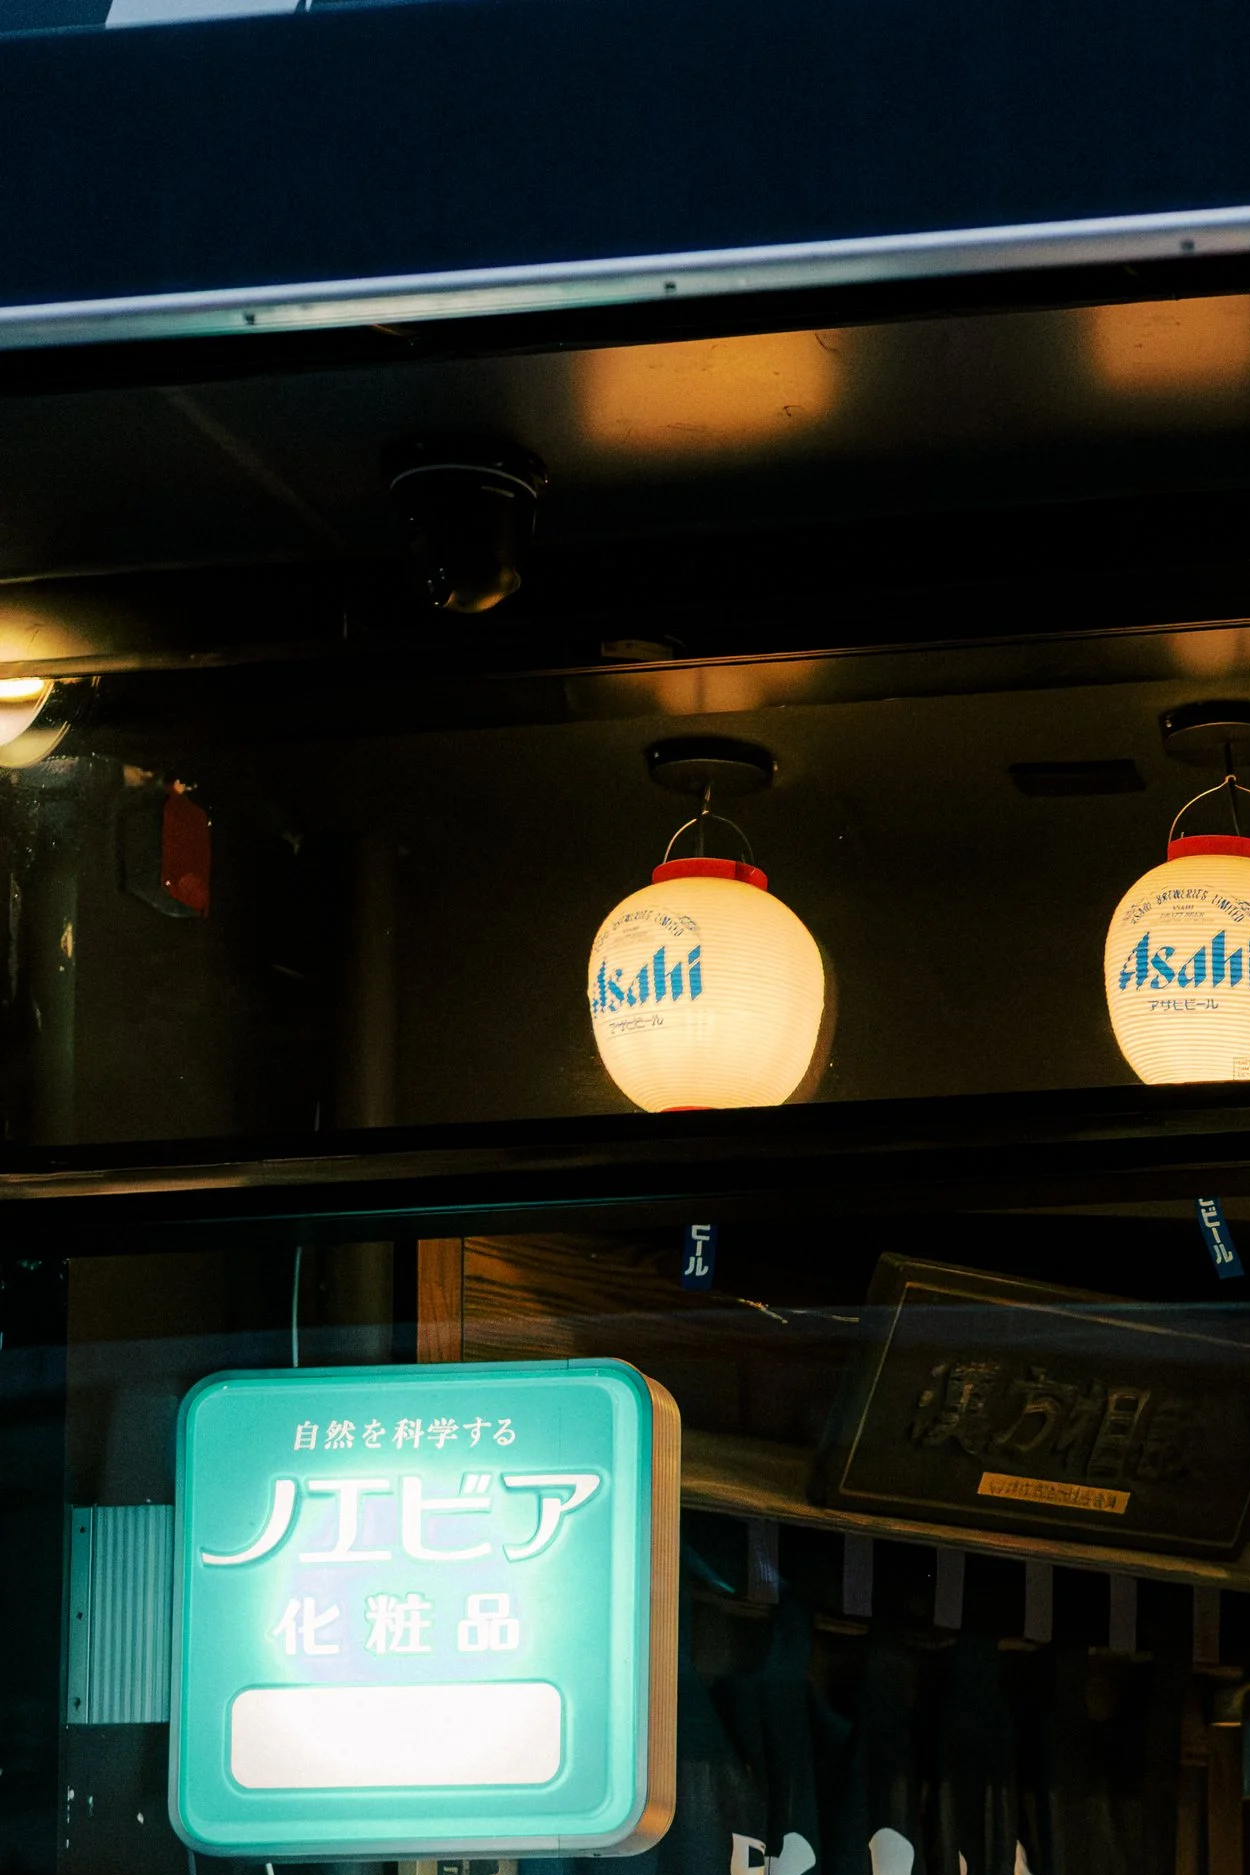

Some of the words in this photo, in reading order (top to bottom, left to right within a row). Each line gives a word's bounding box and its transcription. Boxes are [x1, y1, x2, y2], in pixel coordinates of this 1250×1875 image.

[1148, 998, 1220, 1013] アサヒビール
[292, 1417, 519, 1452] 自然を科学する
[200, 1472, 602, 1567] ノエビア
[272, 1591, 522, 1657] 化粧品
